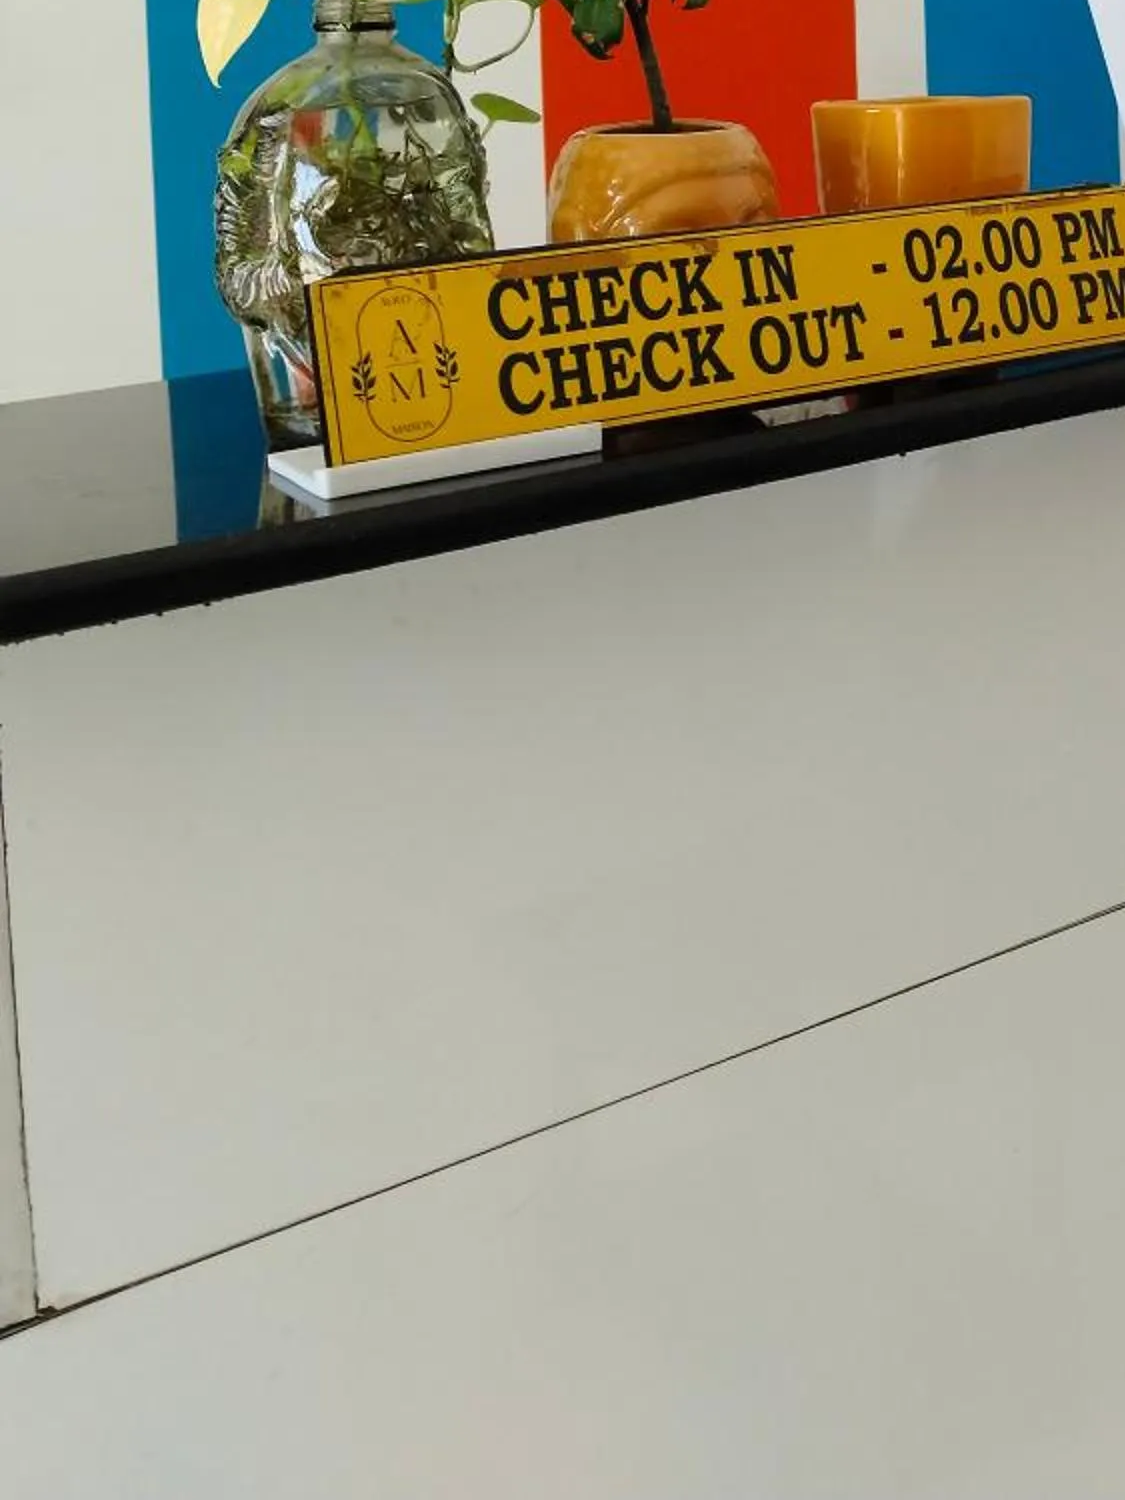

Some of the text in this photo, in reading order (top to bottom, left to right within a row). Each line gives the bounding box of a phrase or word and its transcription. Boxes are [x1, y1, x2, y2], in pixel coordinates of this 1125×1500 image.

[486, 253, 722, 341] CHECK
[733, 244, 799, 307] IN
[903, 216, 1043, 284] 02.00
[1052, 206, 1125, 264] PM
[389, 366, 427, 404] M
[498, 323, 735, 416] CHECK
[749, 302, 867, 375] OUT
[922, 276, 1059, 349] 12.00
